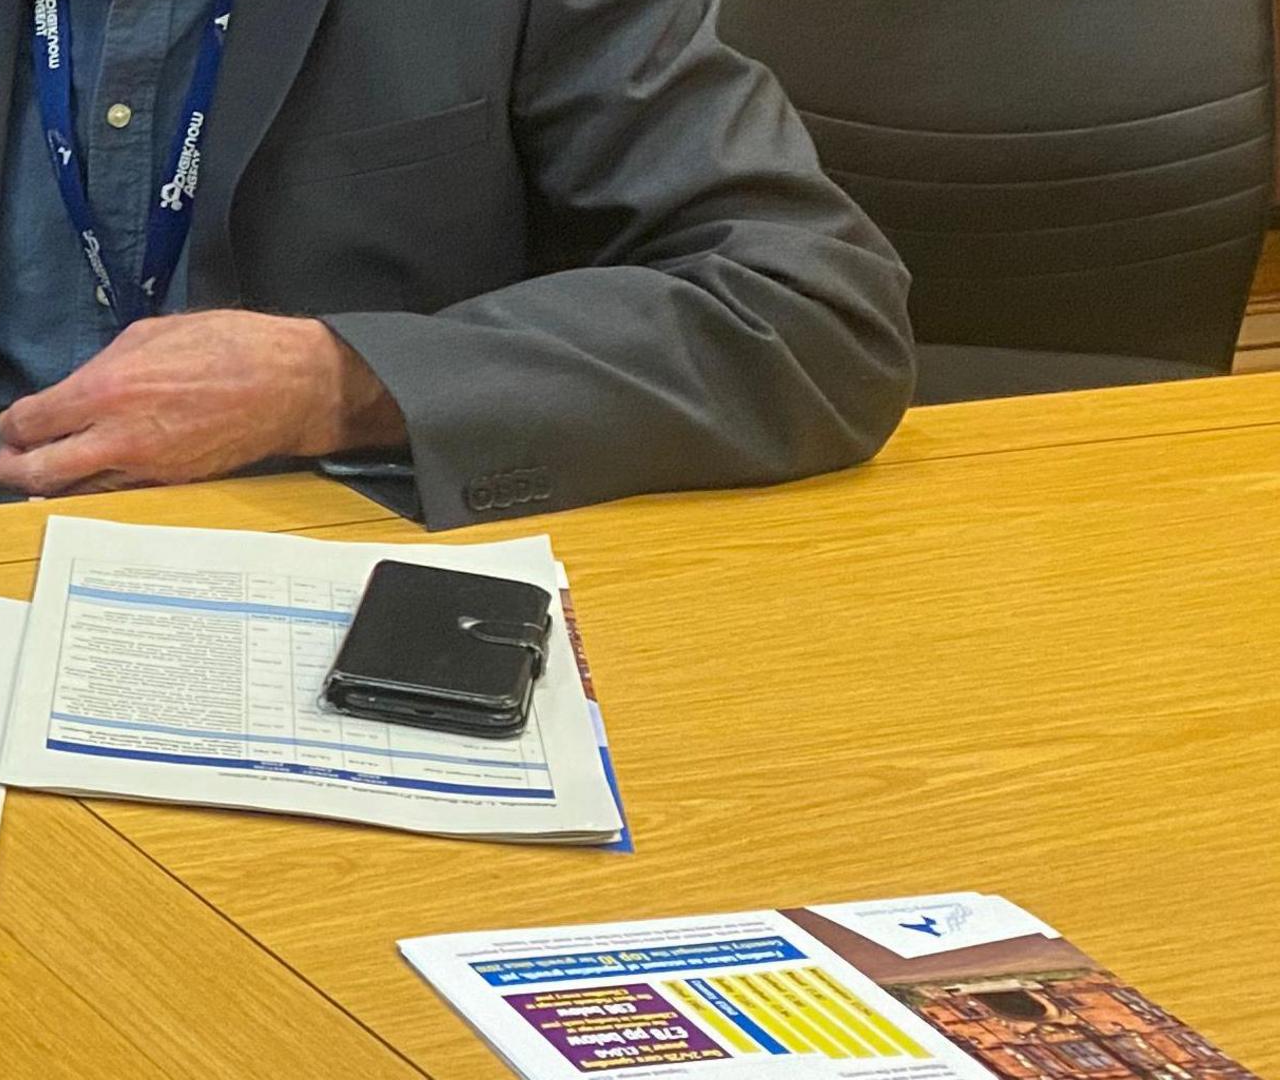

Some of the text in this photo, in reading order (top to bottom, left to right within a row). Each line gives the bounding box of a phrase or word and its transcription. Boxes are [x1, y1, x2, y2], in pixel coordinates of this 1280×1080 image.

[598, 954, 615, 965] 10
[618, 950, 648, 963] top
[736, 949, 782, 961] Funding
[564, 963, 625, 976] population
[640, 959, 686, 969] account
[556, 1005, 603, 1018] below
[566, 1031, 622, 1048] below
[621, 1027, 647, 1040] pp
